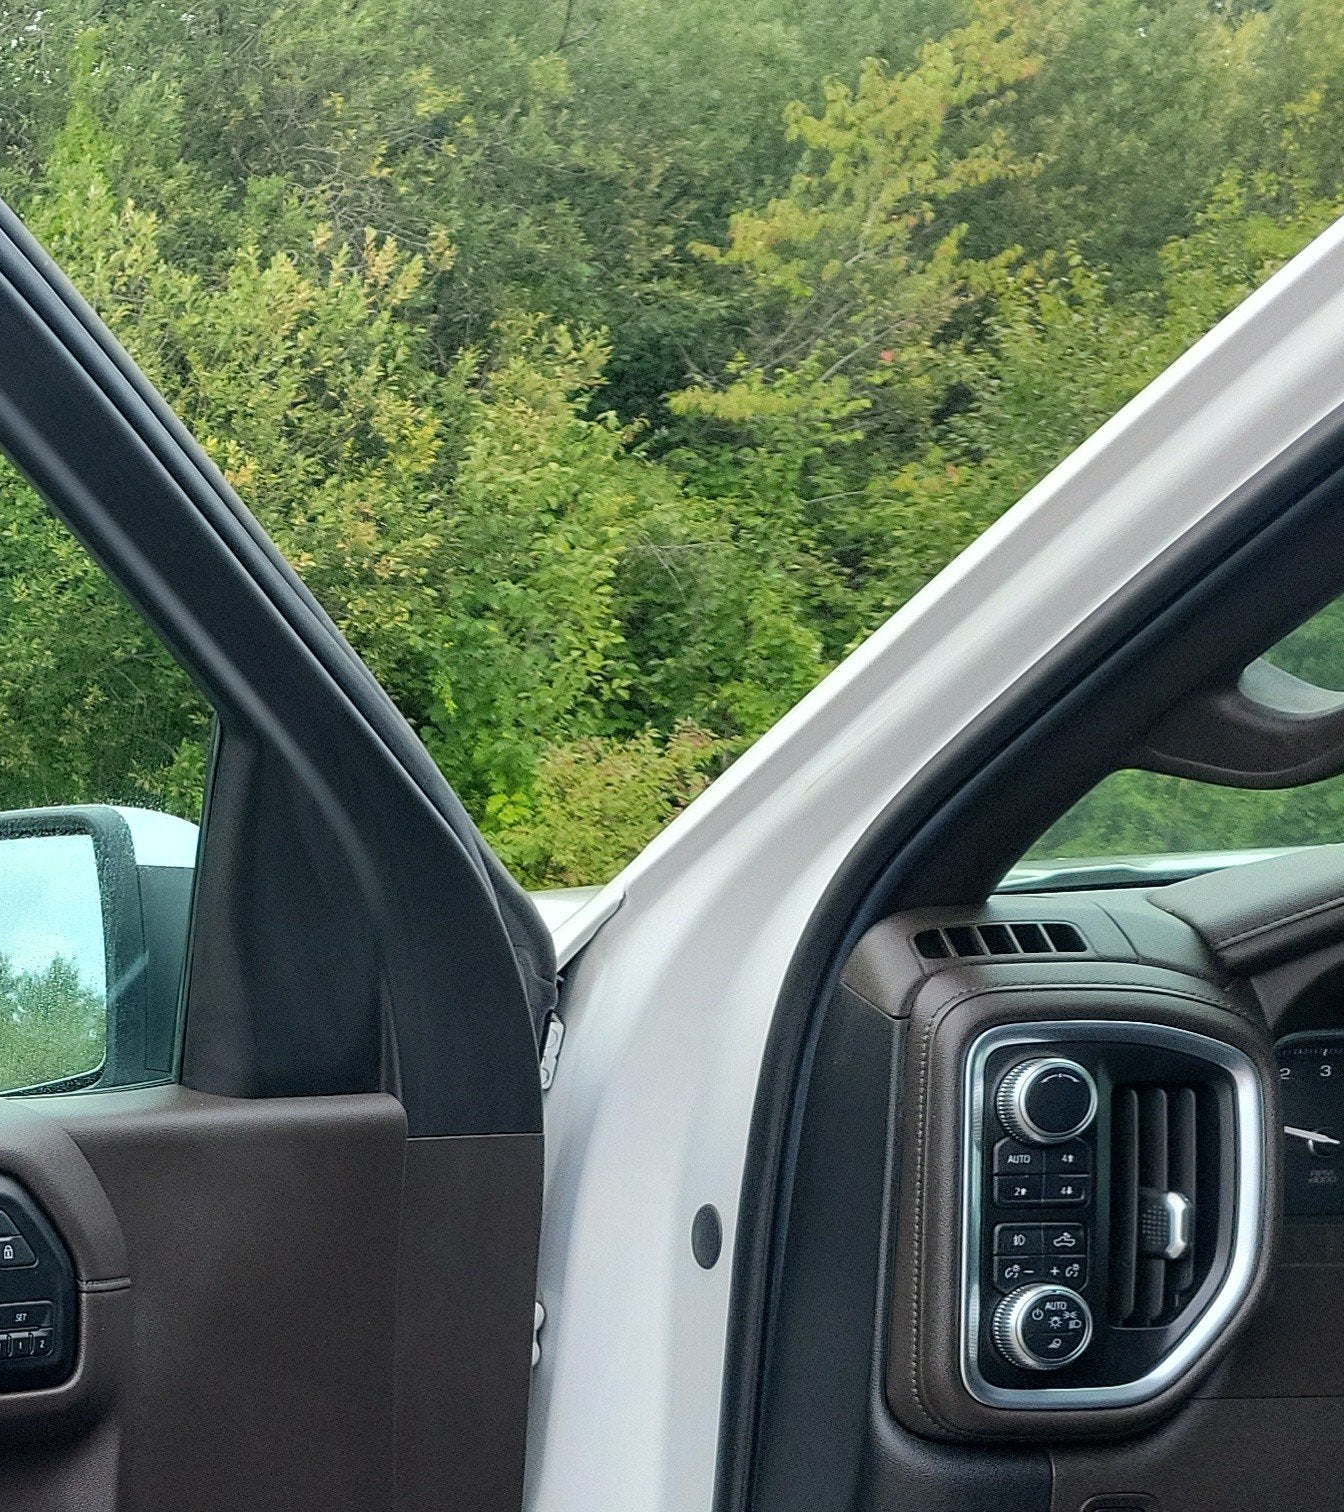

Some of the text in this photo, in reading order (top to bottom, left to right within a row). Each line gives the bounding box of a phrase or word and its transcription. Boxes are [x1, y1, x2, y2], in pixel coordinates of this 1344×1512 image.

[1279, 1067, 1292, 1080] 2
[1320, 1065, 1332, 1077] 3
[1007, 1154, 1031, 1164] AUTO
[1014, 1187, 1021, 1196] 2
[1044, 1301, 1067, 1310] AUTO
[15, 1313, 27, 1322] SET
[39, 1339, 45, 1348] 2
